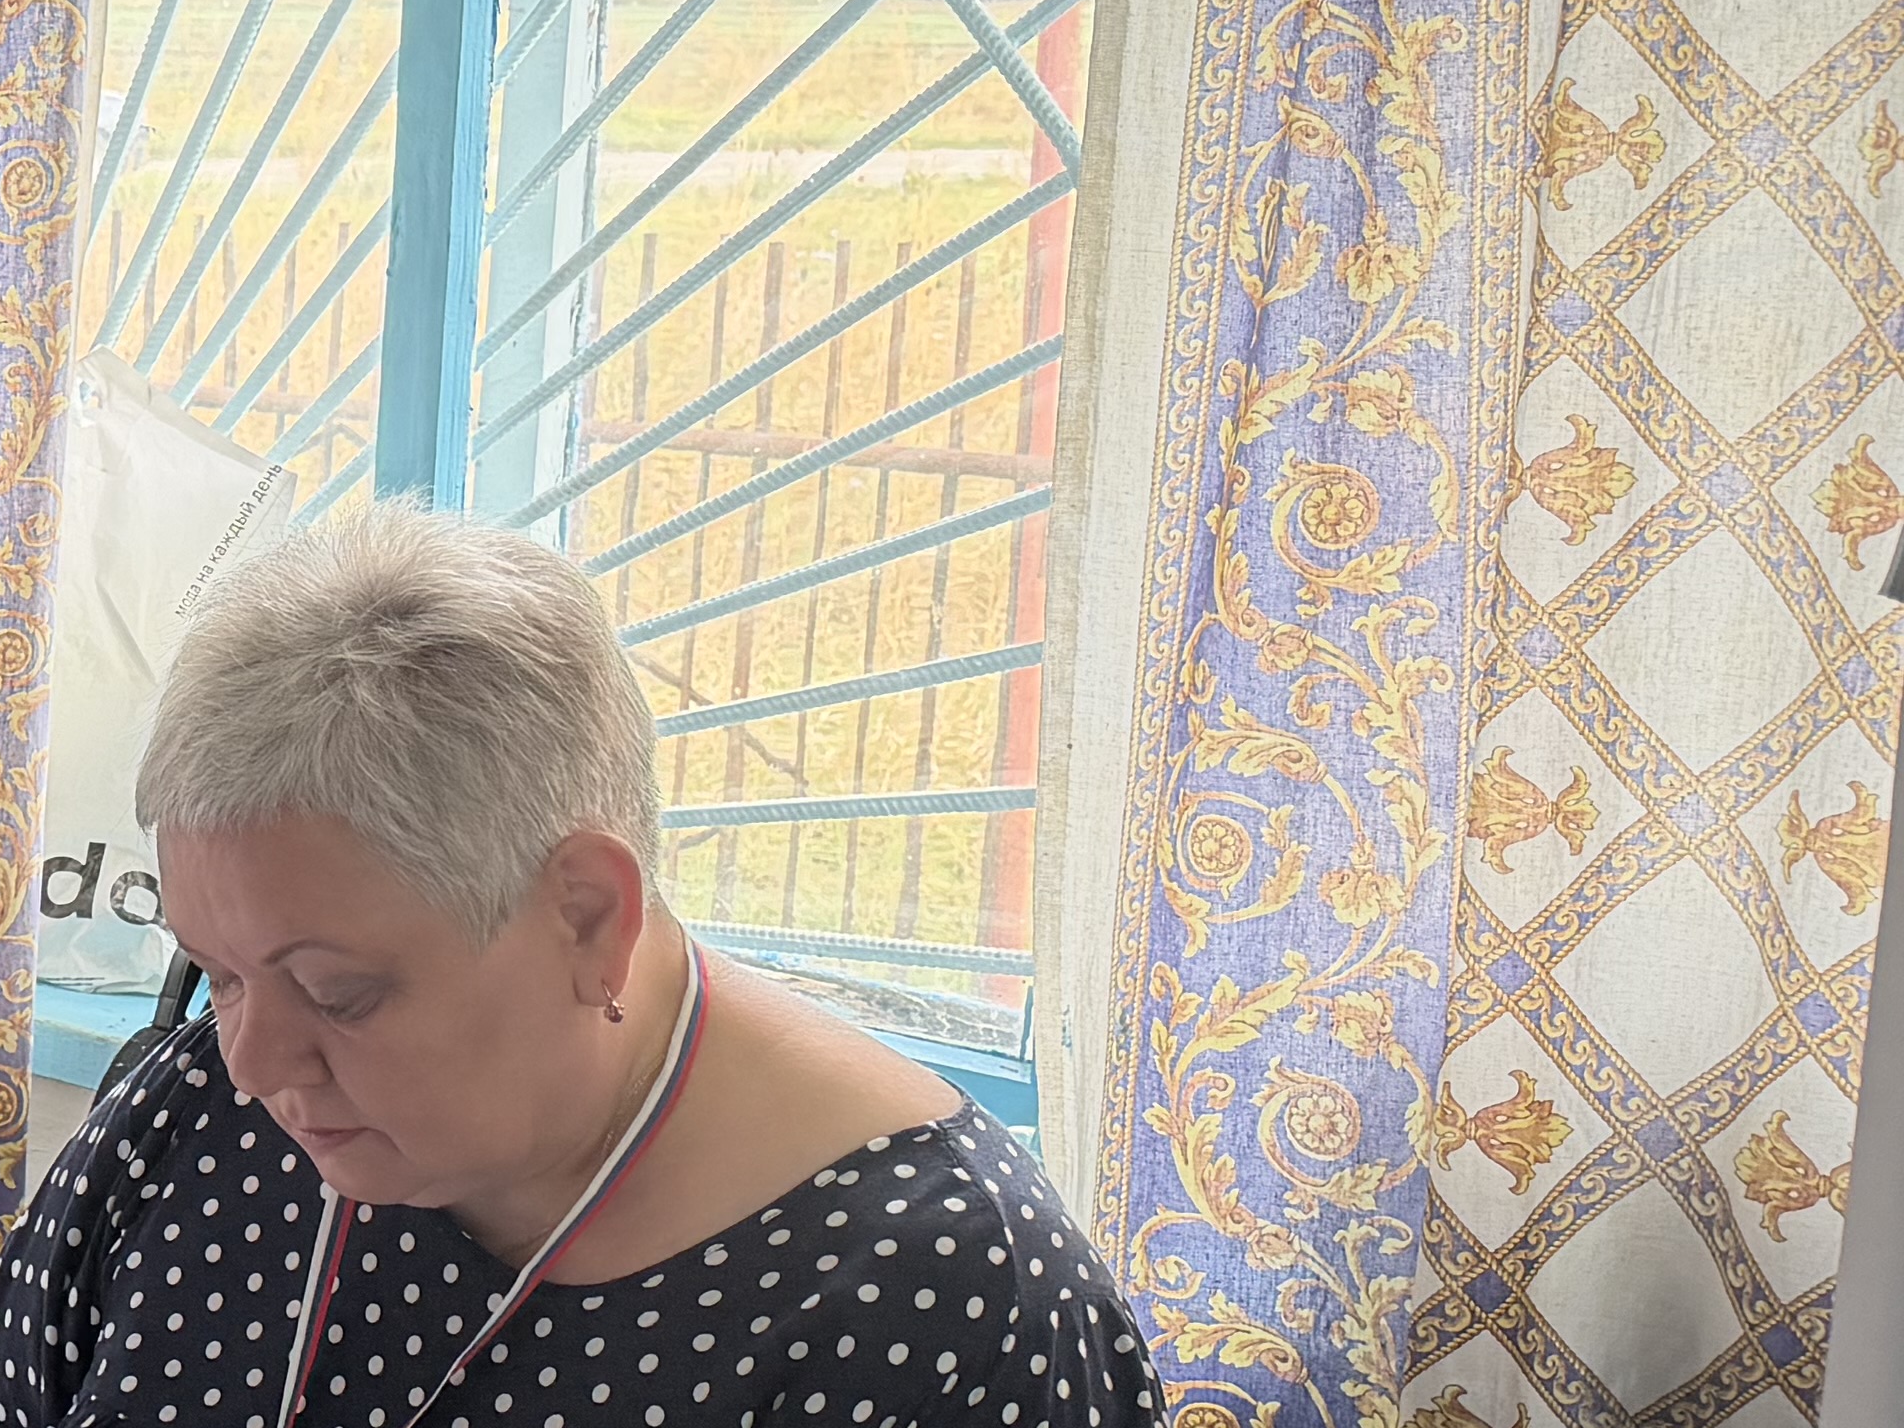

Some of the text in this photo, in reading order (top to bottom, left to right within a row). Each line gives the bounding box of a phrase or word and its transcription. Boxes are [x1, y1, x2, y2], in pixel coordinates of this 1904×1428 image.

[174, 464, 284, 620] Мода на каждый день
